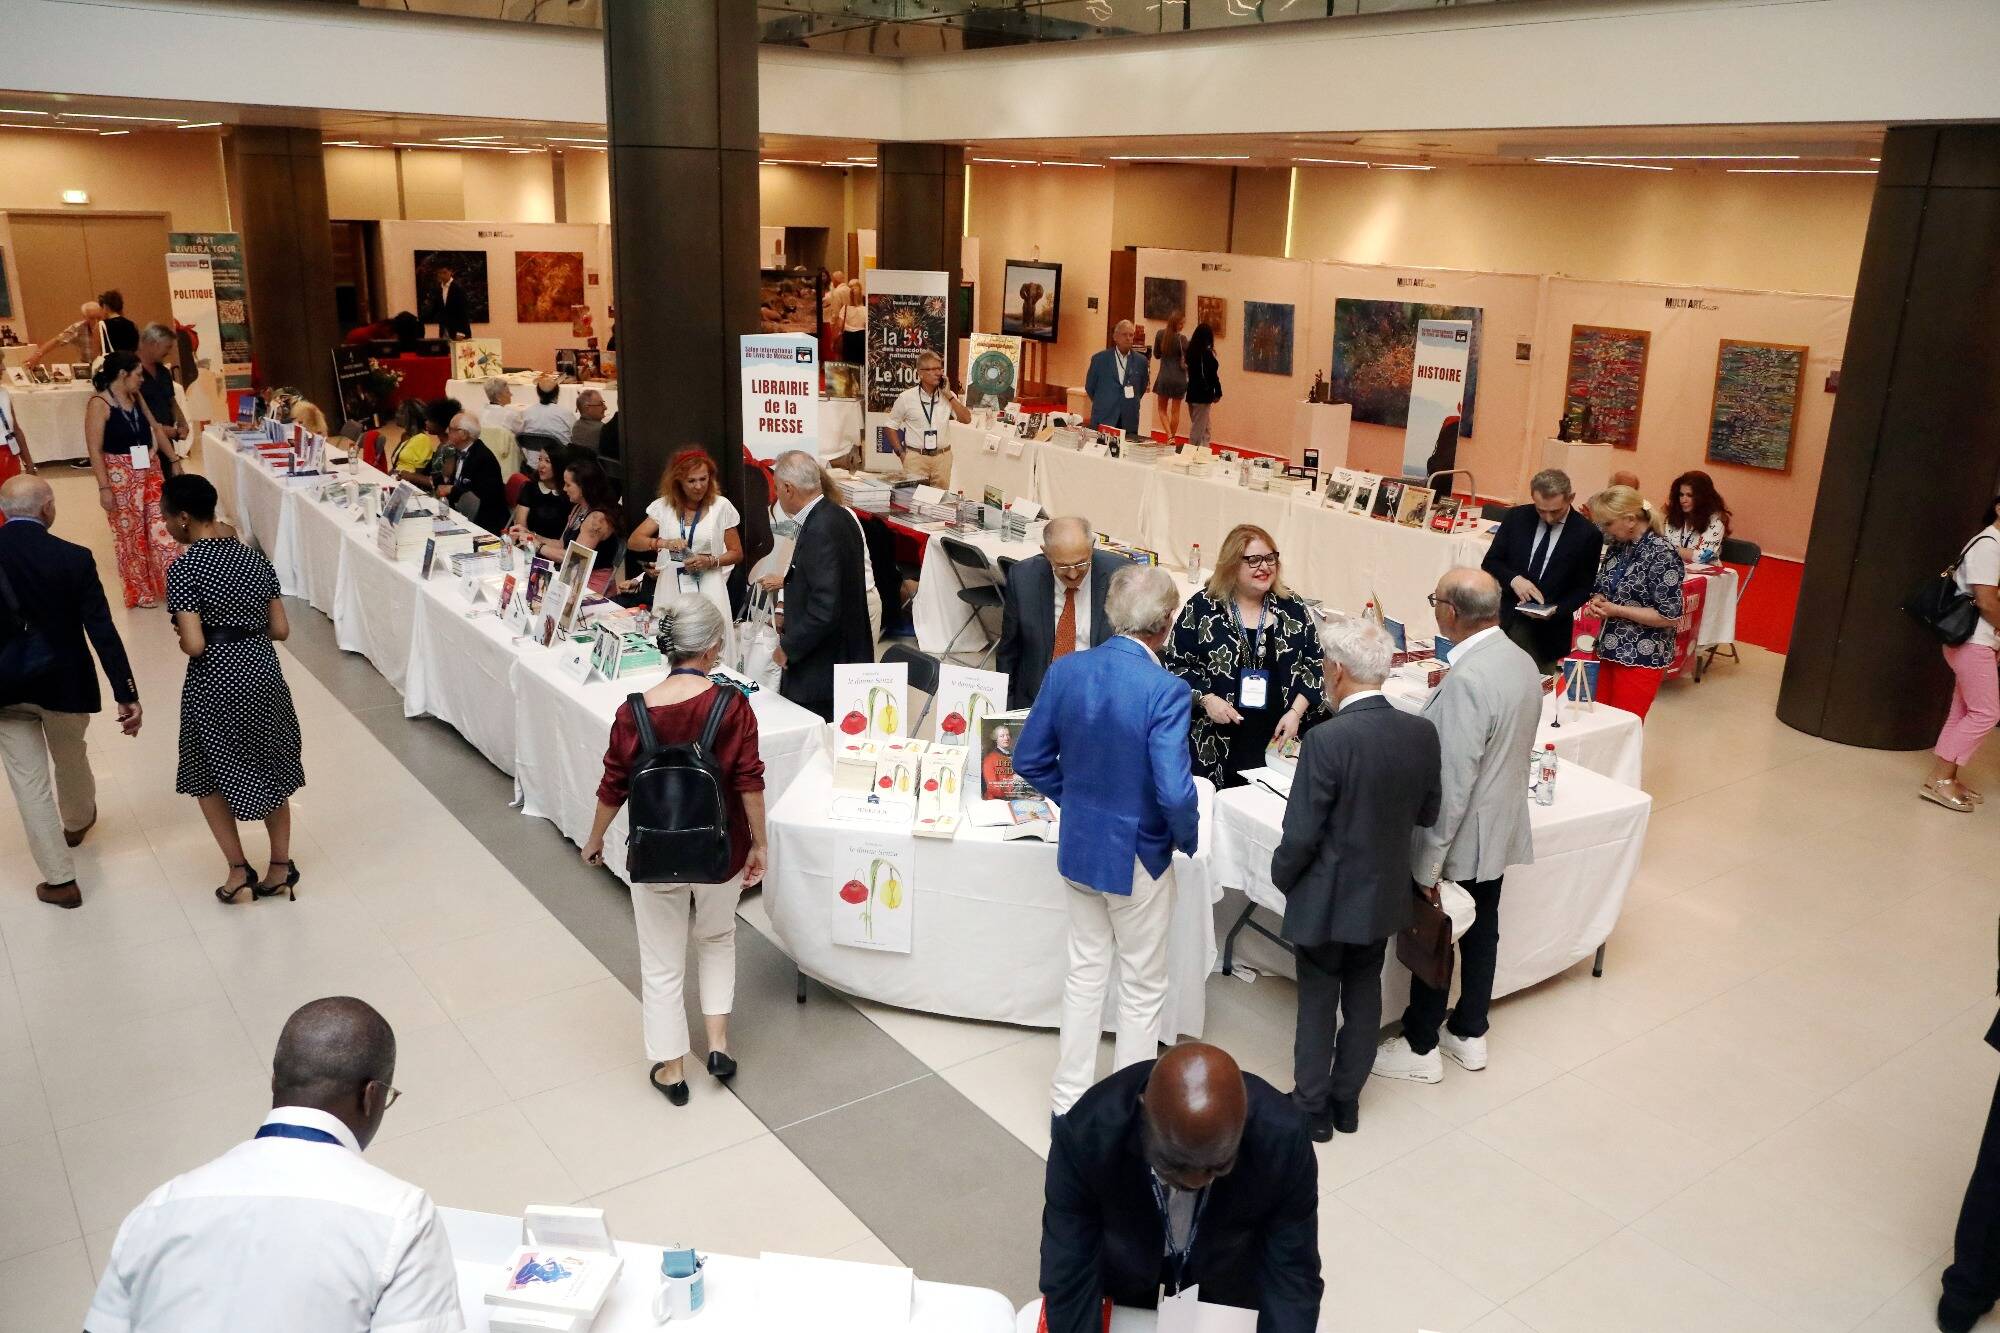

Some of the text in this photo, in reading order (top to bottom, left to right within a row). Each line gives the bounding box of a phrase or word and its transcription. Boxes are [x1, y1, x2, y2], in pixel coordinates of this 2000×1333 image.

[195, 236, 215, 245] ART
[175, 245, 237, 254] RIVIERA TOUR
[173, 288, 214, 300] POLITIQUE
[1665, 297, 1687, 308] MULTI
[1687, 299, 1703, 310] ART
[882, 327, 898, 346] la
[875, 367, 892, 382] Le
[1417, 365, 1462, 383] HISTOIRE
[751, 379, 809, 396] LIBRAIRIE
[764, 399, 797, 414] de la
[759, 417, 803, 433] PRESSE
